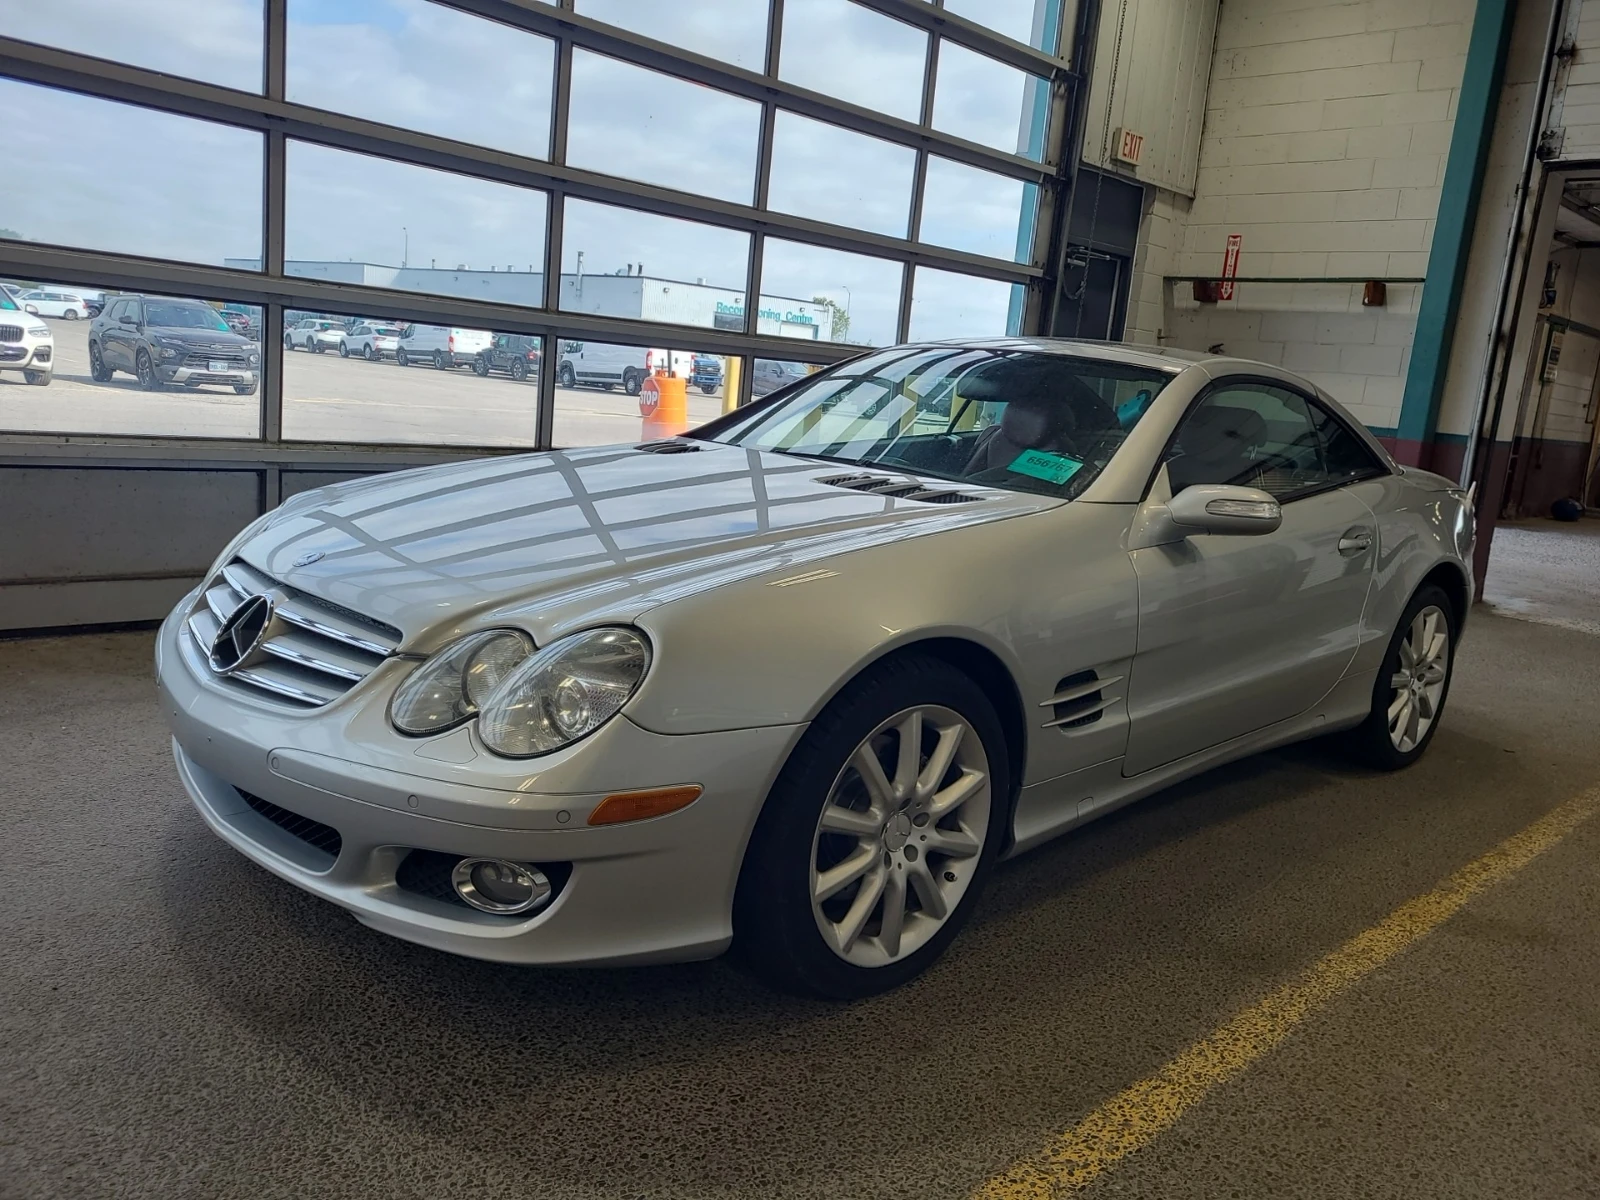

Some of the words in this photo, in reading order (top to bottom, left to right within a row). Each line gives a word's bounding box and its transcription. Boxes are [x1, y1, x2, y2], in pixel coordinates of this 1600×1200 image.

[1122, 131, 1143, 161] EXIT
[786, 311, 813, 324] Centre
[639, 390, 658, 405] STOP
[1026, 456, 1073, 473] 656767
